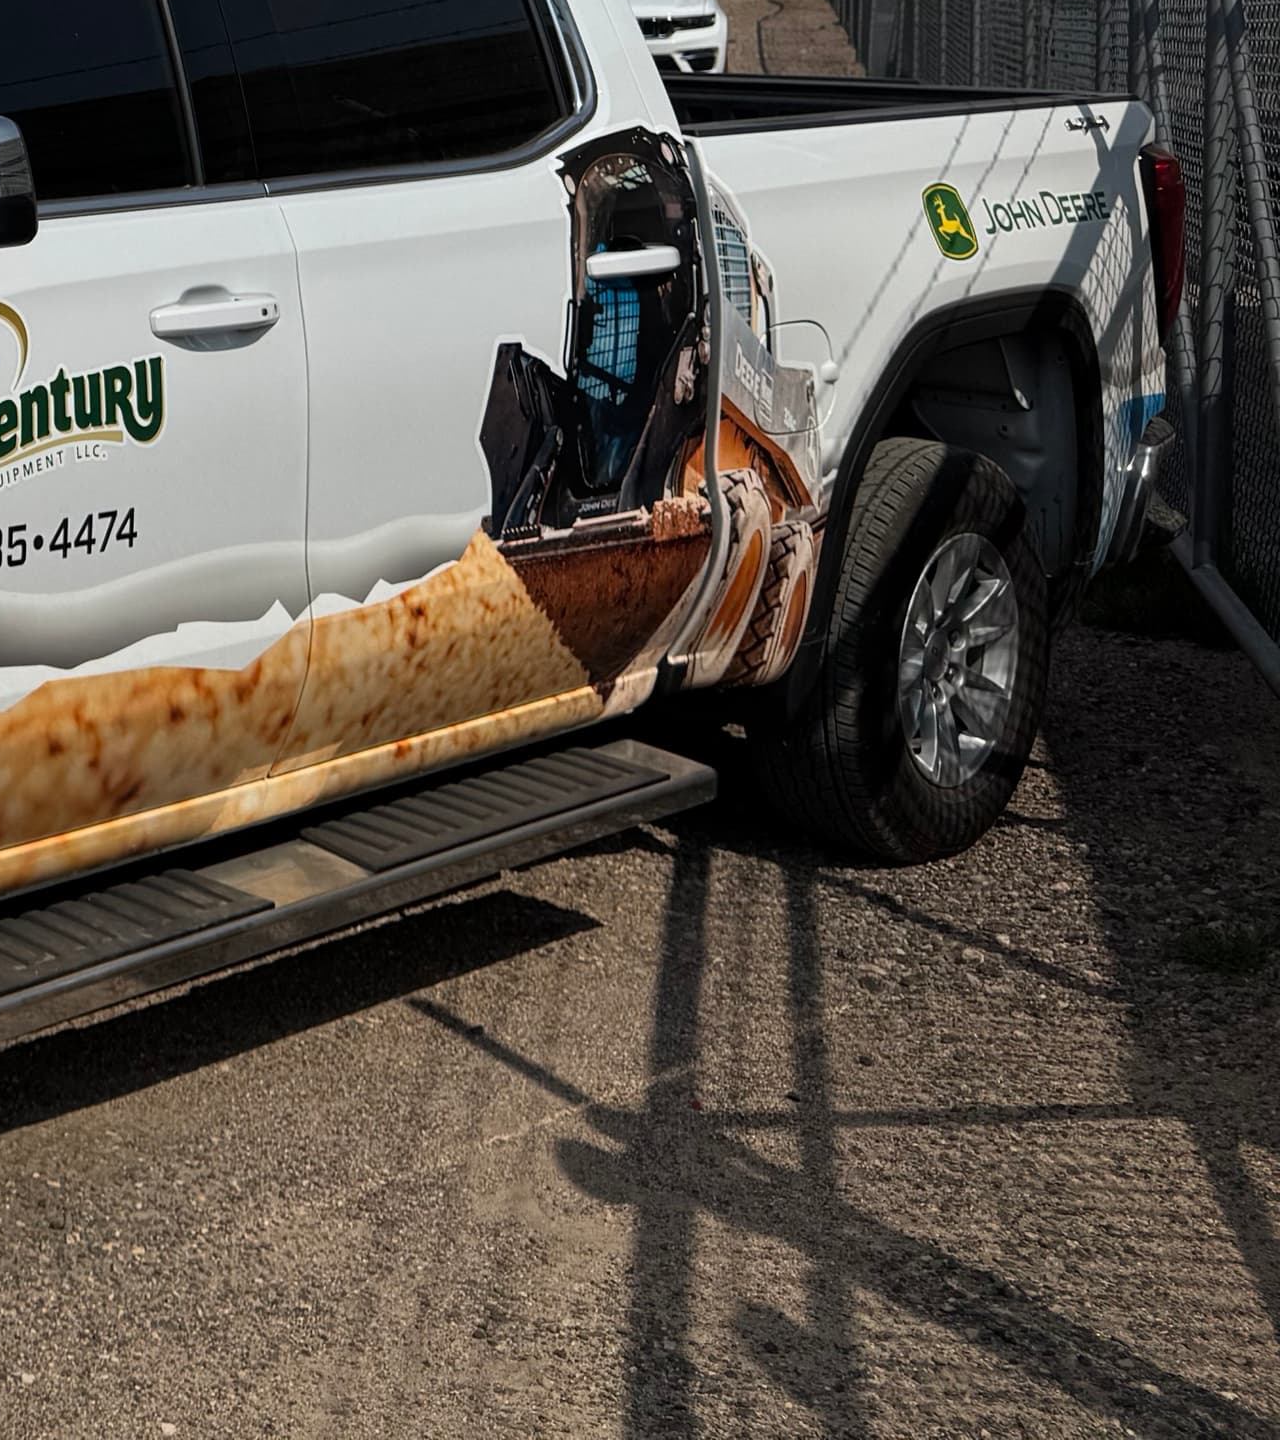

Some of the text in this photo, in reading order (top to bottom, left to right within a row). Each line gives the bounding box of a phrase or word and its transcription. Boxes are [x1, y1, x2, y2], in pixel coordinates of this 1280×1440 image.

[982, 190, 1111, 235] JOHN DEERE
[75, 444, 106, 460] LLC.
